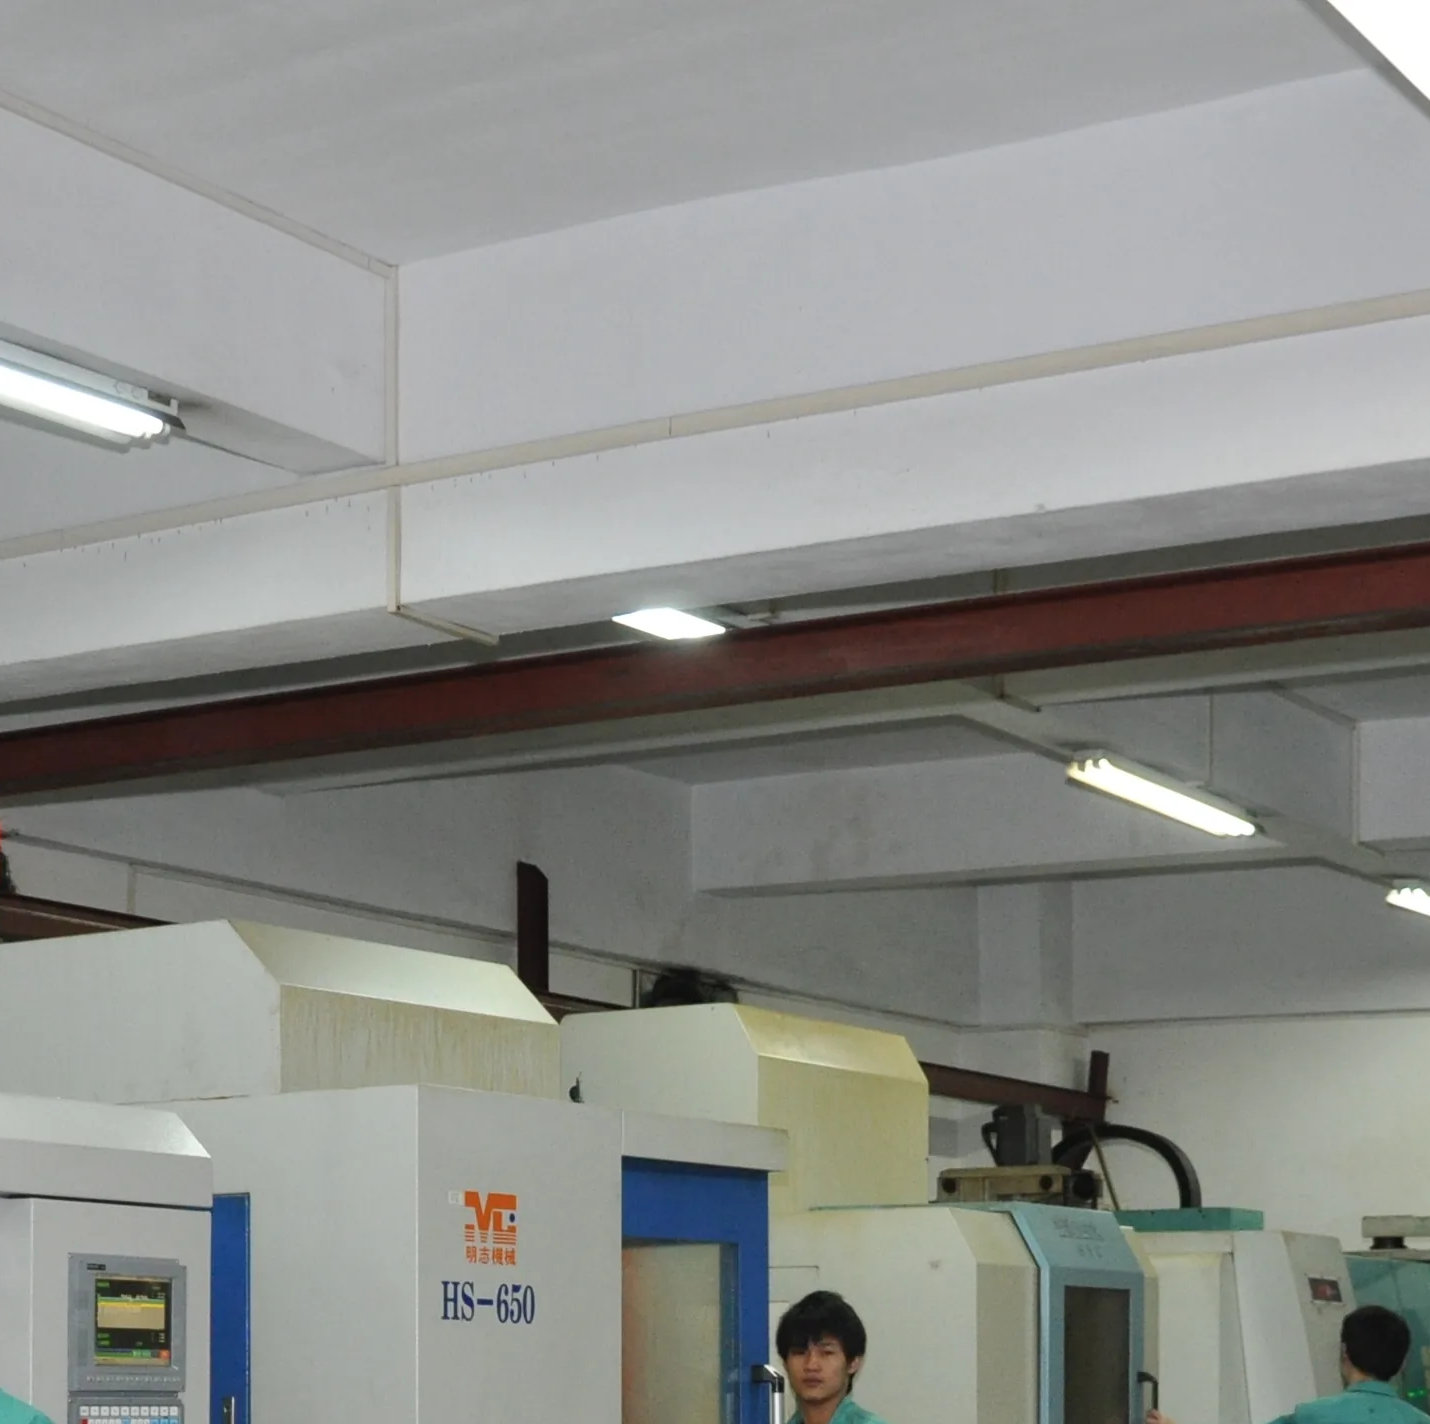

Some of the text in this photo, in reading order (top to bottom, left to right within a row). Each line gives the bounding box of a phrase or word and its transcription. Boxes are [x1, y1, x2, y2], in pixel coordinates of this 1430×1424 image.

[465, 1246, 516, 1266] 明志機械
[441, 1281, 535, 1324] HS-650
